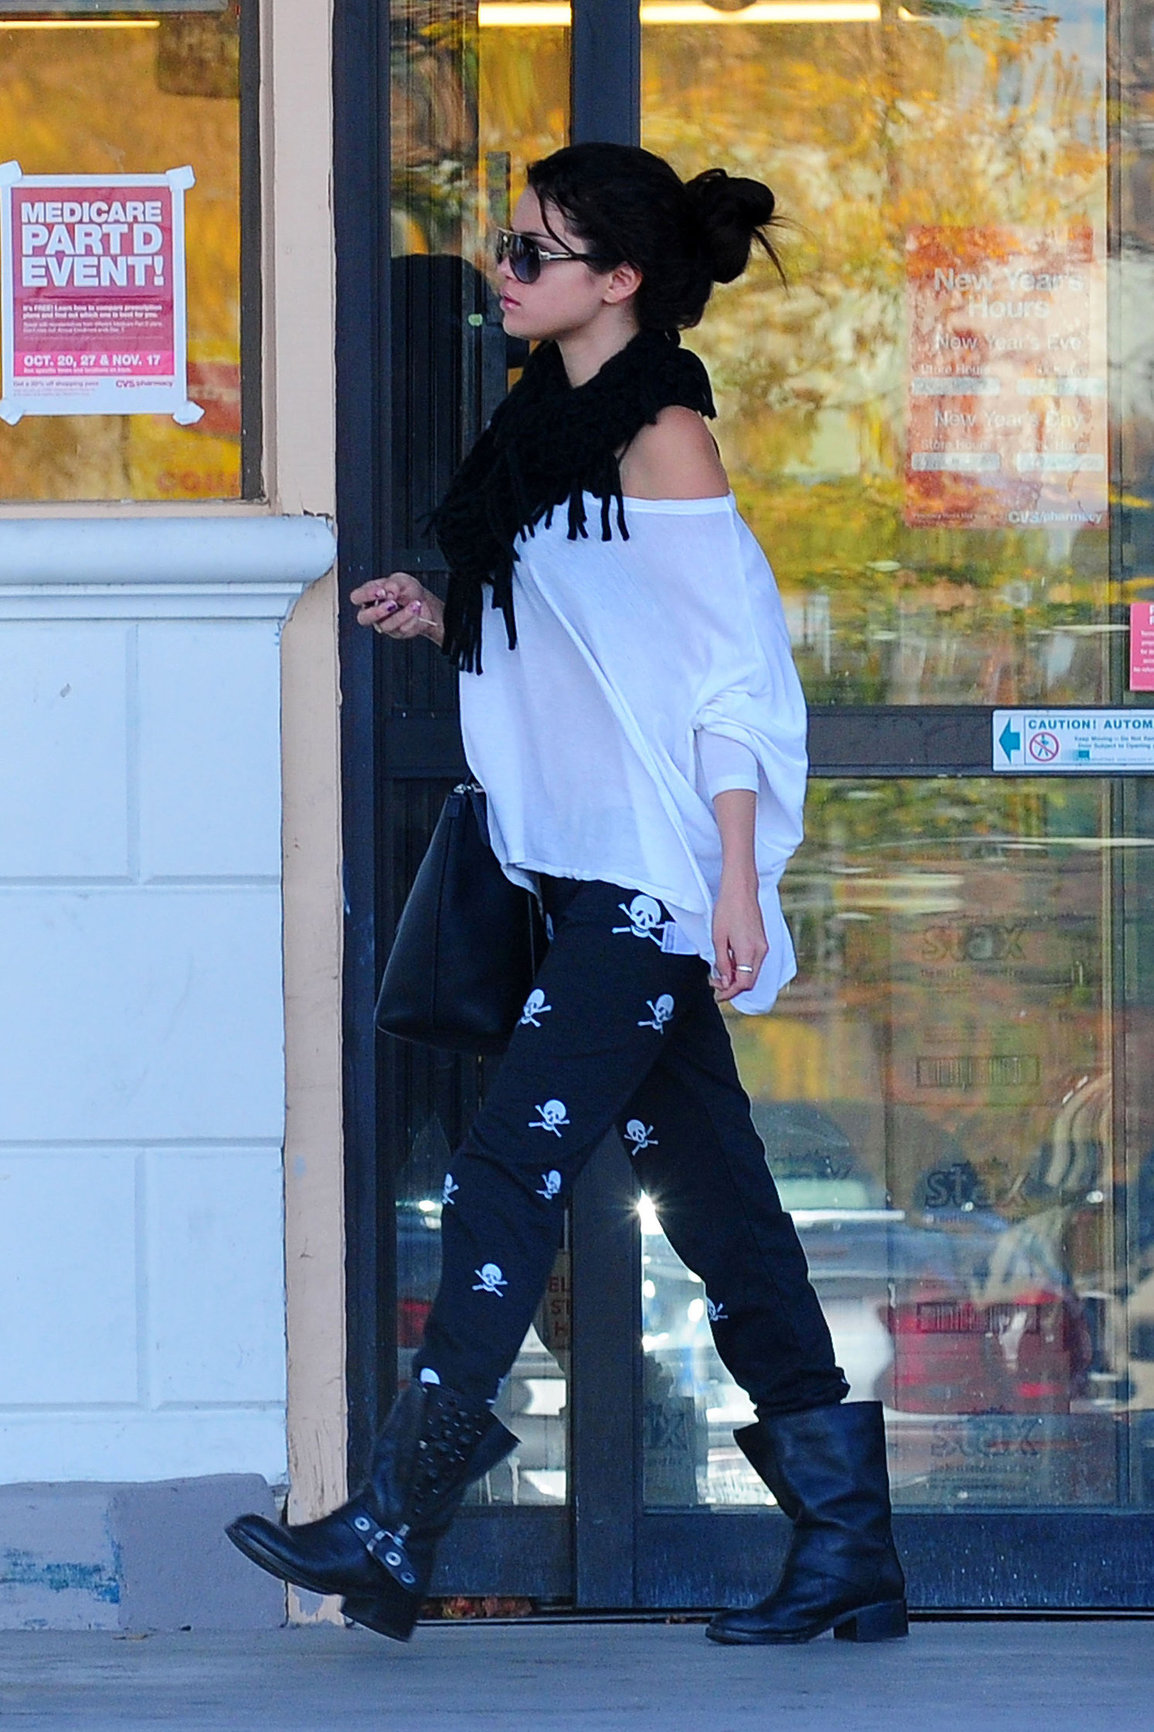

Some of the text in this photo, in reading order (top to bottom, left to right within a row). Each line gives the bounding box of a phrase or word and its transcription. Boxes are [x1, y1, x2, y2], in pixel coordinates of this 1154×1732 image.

[21, 201, 162, 223] MEDICARE
[22, 223, 163, 255] PART D
[22, 255, 164, 287] EVENT!
[934, 267, 993, 291] New
[968, 295, 1050, 318] Hours
[935, 332, 978, 350] New
[24, 355, 54, 367] OCT.
[57, 355, 77, 368] 20,
[80, 355, 96, 367] 27
[112, 354, 142, 366] NOV.
[147, 354, 161, 366] 17
[934, 410, 976, 428] New
[1028, 719, 1154, 730] CAUTION! AUTOM
